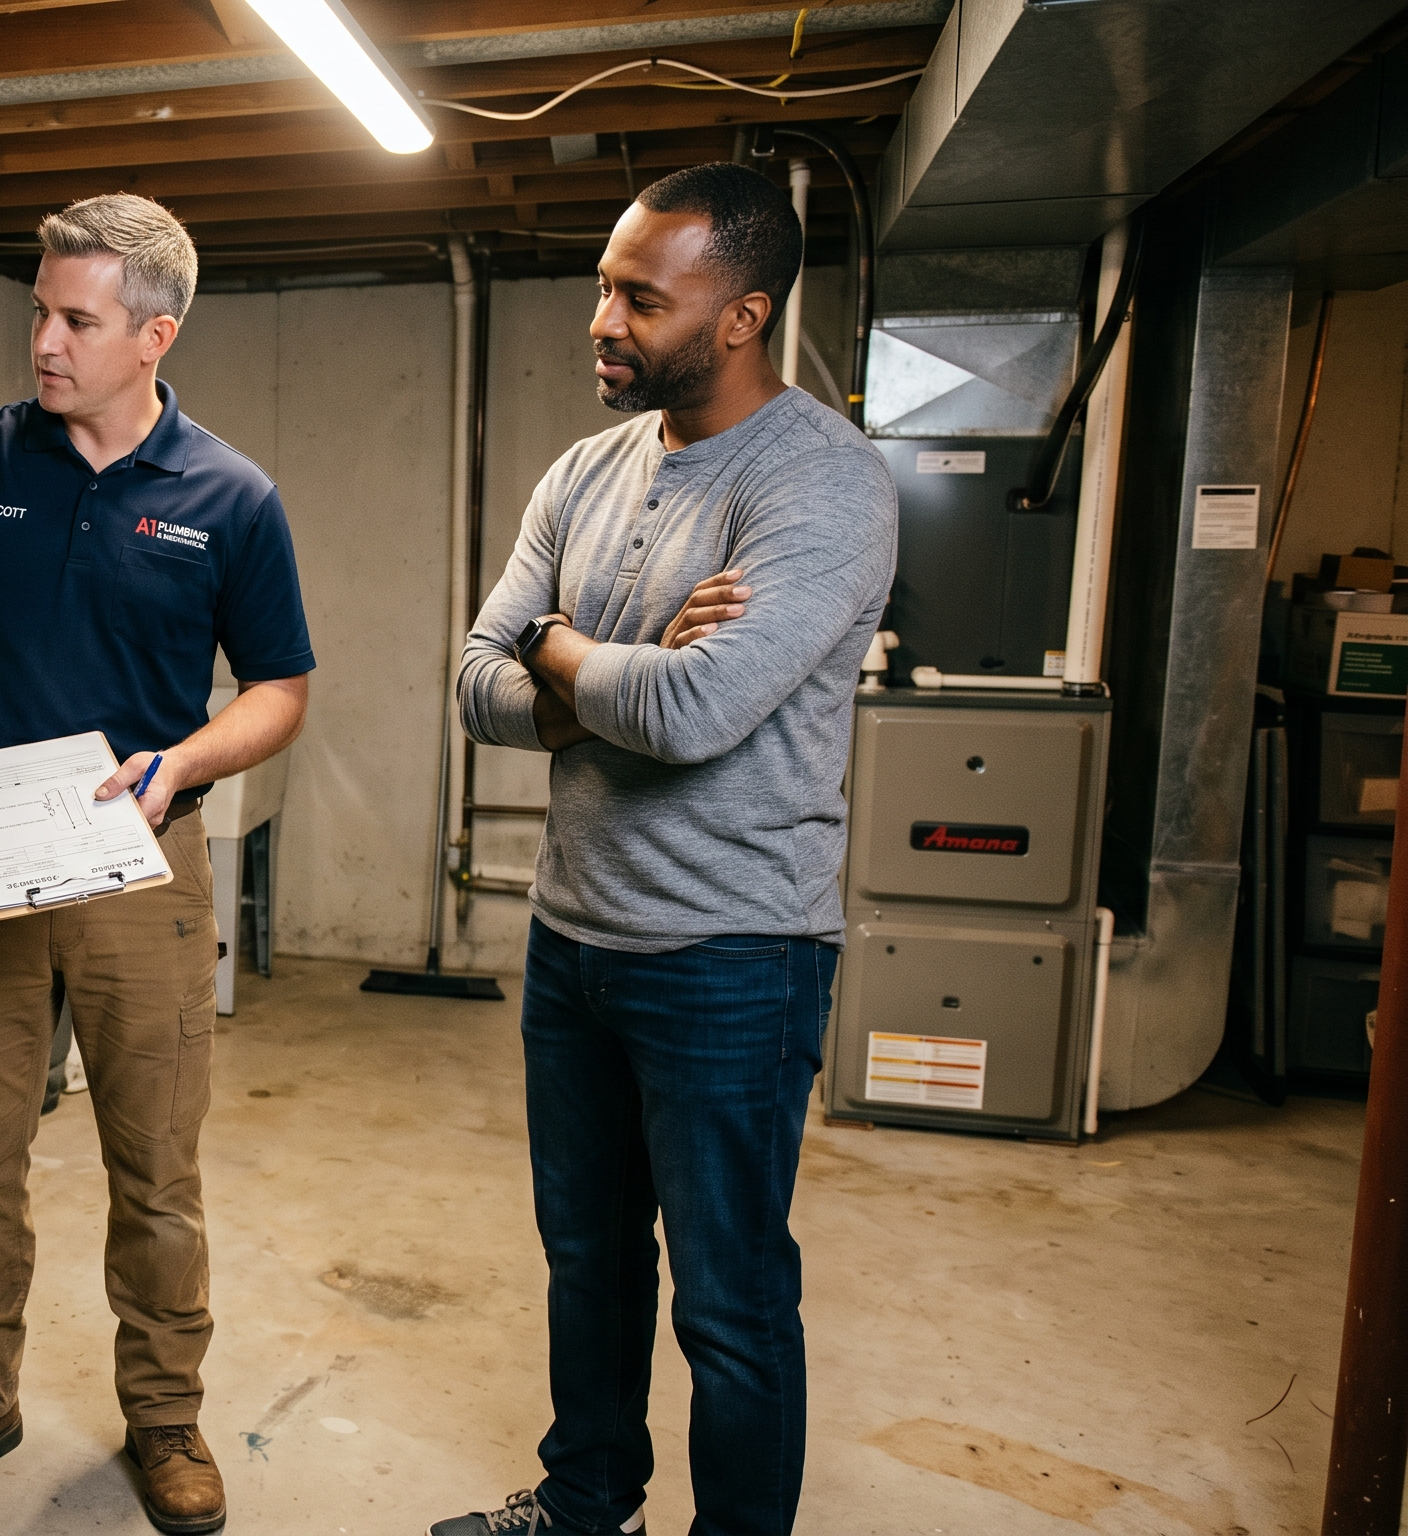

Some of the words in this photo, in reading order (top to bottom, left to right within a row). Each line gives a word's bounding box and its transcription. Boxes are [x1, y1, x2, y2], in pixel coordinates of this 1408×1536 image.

[135, 516, 157, 537] A1
[157, 521, 210, 542] PLUMBING
[923, 825, 1021, 852] Amana
